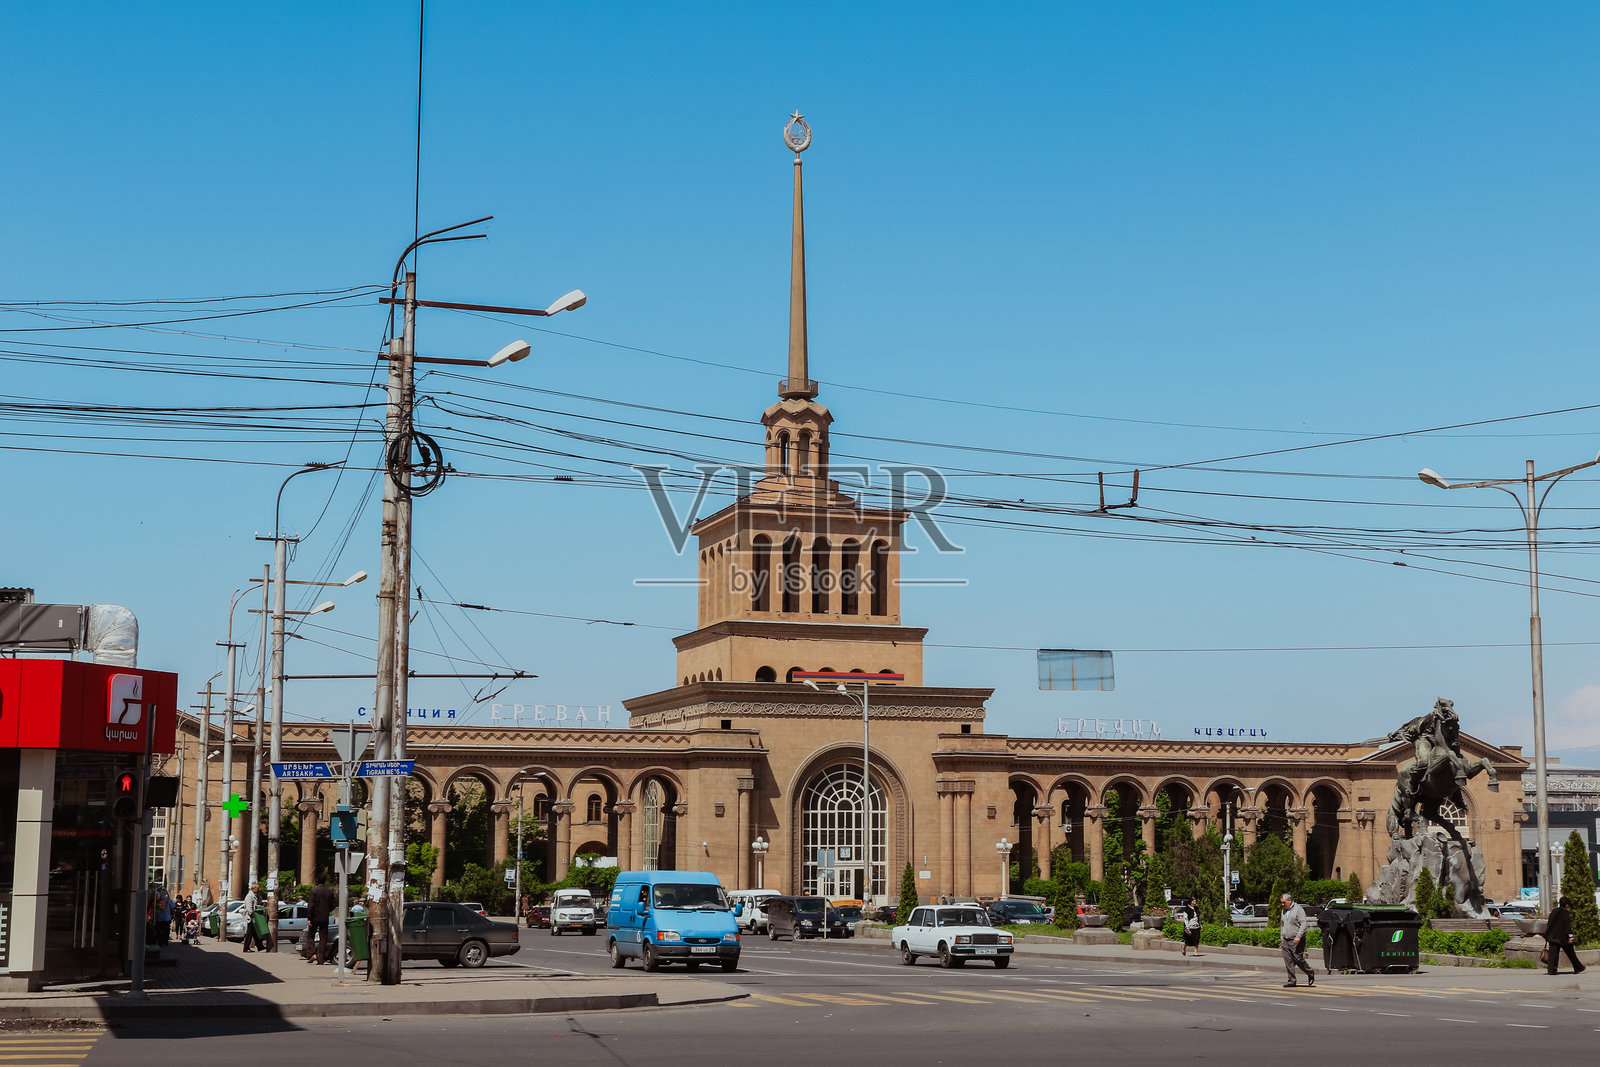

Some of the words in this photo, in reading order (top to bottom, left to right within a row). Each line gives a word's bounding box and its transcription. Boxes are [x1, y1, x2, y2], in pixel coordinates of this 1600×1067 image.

[358, 707, 456, 718] СНЦИЯ
[491, 703, 611, 721] ЕРЕВАН
[105, 726, 138, 742] կարաս
[1057, 717, 1161, 734] ԵՐԵՎԱՆ
[1194, 727, 1267, 737] ԿԱՅԱՐԱՆ
